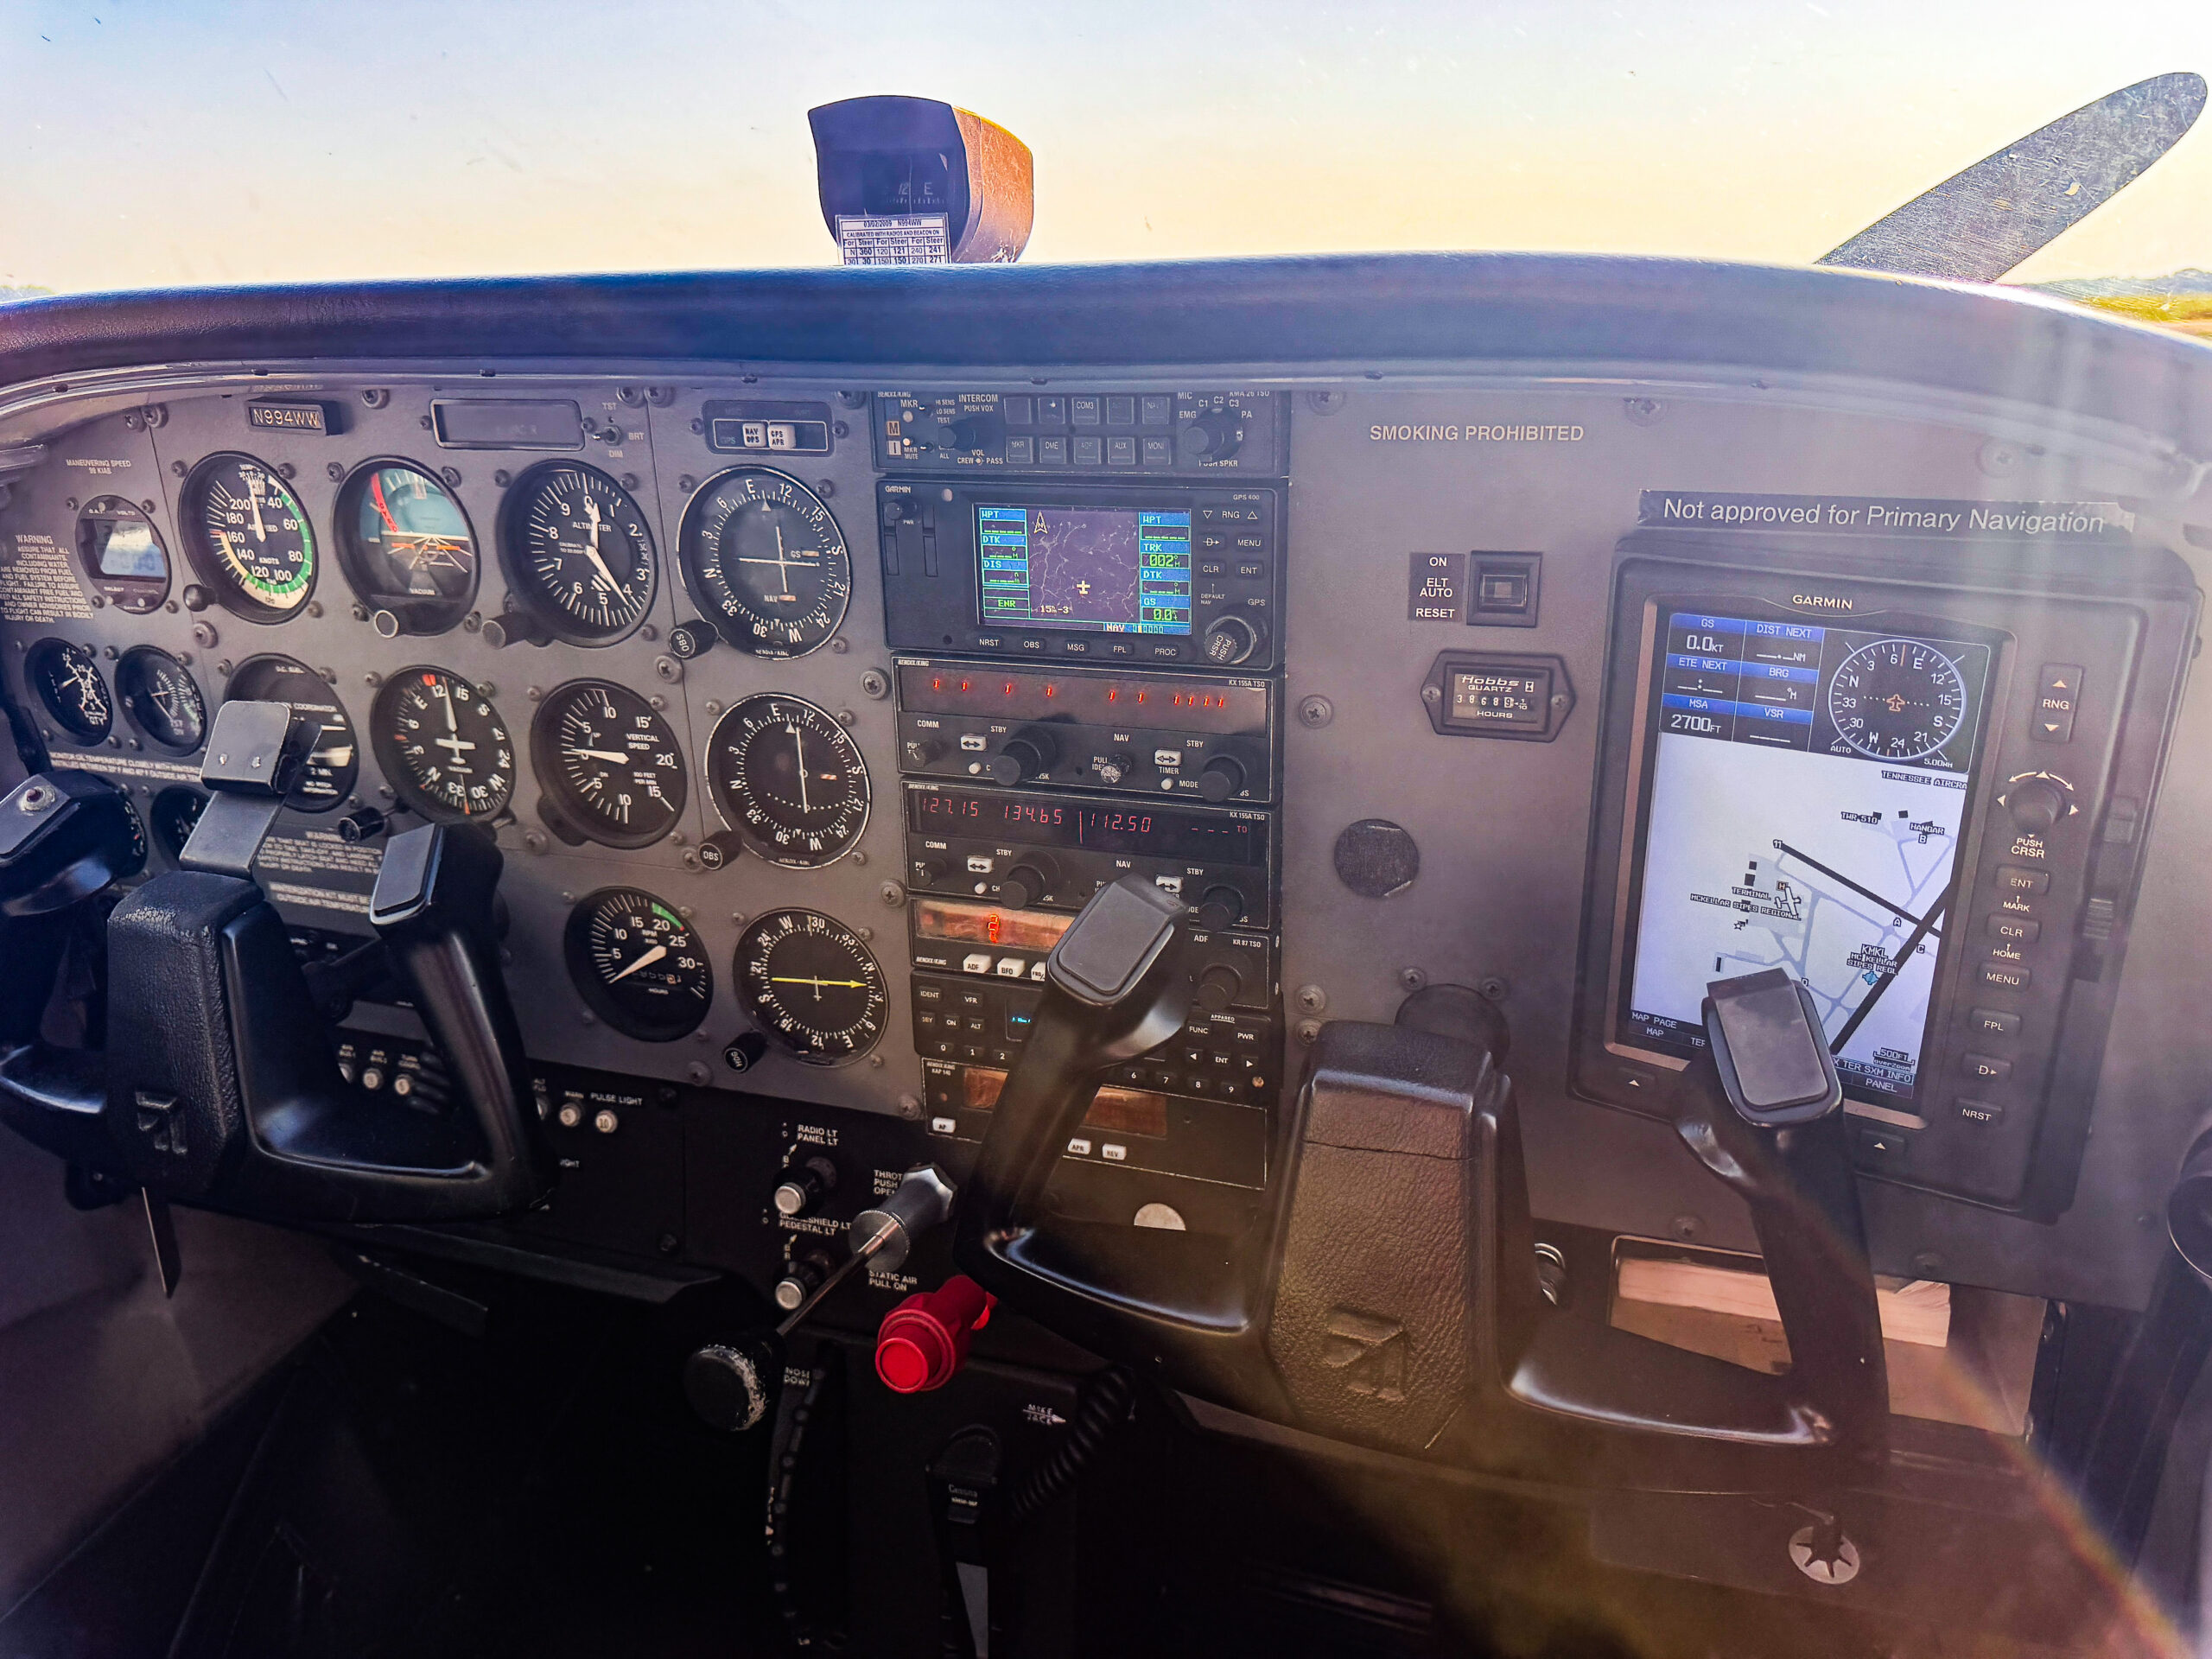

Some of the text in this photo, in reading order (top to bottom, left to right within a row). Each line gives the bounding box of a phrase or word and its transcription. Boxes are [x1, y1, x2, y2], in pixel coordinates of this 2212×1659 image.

[958, 394, 998, 403] INTERCOM
[1177, 391, 1192, 400] MIC
[1213, 396, 1224, 404] C2
[900, 399, 918, 408] MKR
[1077, 401, 1094, 410] COM3
[253, 409, 319, 428] N994WW
[1179, 410, 1197, 419] EMG
[628, 432, 645, 441] BRT
[1370, 425, 1585, 442] SMOKING PROHIBITED
[229, 498, 251, 511] 200
[267, 496, 283, 508] 40
[226, 512, 245, 524] 180
[1662, 499, 2104, 534] Not approved for Primary Navigation
[283, 518, 298, 531] 60
[227, 531, 245, 543] 160
[1237, 538, 1262, 547] MENU
[238, 548, 255, 561] 140
[288, 550, 303, 563] 80
[983, 560, 1001, 569] DIS
[1428, 556, 1448, 567] ON
[251, 565, 270, 578] 120
[275, 569, 293, 582] 100
[1143, 570, 1162, 579] DTK
[1426, 577, 1448, 588] ELT
[1419, 588, 1453, 598] AUTO
[1247, 598, 1266, 607] GPS
[1792, 594, 1853, 610] GARMIN
[1415, 607, 1456, 619] RESET
[1106, 624, 1125, 632] NAV
[1700, 618, 1812, 639] GS DIST NEXT
[1023, 640, 1039, 649] OBS
[1067, 643, 1084, 652] MSG
[1679, 658, 1727, 671] ETE NEXT
[1769, 667, 1789, 678] BRG
[1462, 675, 1520, 688] Hobbs
[1930, 673, 1945, 685] 12
[1468, 684, 1512, 693] QUARTZ
[1688, 698, 1708, 709] MSA
[1841, 696, 1857, 709] 33
[1937, 694, 1952, 706] 15
[2042, 698, 2070, 710] RNG
[1477, 710, 1513, 719] HOURS
[1764, 708, 1784, 719] VSR
[917, 720, 939, 728] COMM
[626, 733, 660, 743] VERTICAL
[1114, 733, 1129, 742] NAV
[1890, 738, 1905, 749] 24
[628, 742, 651, 751] SPEED
[1830, 745, 1852, 754] AUTO
[656, 753, 674, 766] 20
[1158, 766, 1179, 775] TIMER
[1881, 771, 1932, 785] TENNESSEE
[1910, 823, 1945, 835] HANGAR
[925, 841, 947, 849] COMM
[2016, 837, 2044, 849] PUSH
[2011, 845, 2045, 859] CRSR
[1116, 860, 1131, 868] NAV
[2010, 878, 2033, 888] ENT
[1732, 887, 1771, 901] TERMINAL
[2003, 901, 2031, 912] MARK
[630, 916, 645, 929] 15
[652, 918, 671, 931] 20
[614, 928, 628, 941] 10
[1999, 925, 2024, 938] CLR
[669, 934, 687, 948] 25
[1193, 934, 1209, 943] ADF
[1993, 948, 2022, 960] HOME
[678, 957, 696, 969] 30
[1001, 967, 1014, 976] BFO
[1986, 971, 2020, 986] MENU
[920, 990, 939, 999] IDENT
[1631, 1011, 1678, 1029] MAP PAGE
[1984, 1020, 2005, 1032] FPL
[1189, 1026, 1209, 1034] FUNC
[1237, 1032, 1255, 1040] PWR
[1646, 1027, 1664, 1037] MAP
[1864, 1065, 1912, 1083] SXM INFO
[1866, 1077, 1898, 1093] PANEL
[590, 1092, 643, 1106] PULSE LIGHT
[1961, 1109, 1993, 1122] NRST
[798, 1124, 838, 1138] RADIO LT
[797, 1133, 839, 1147] PANEL LT
[779, 1219, 836, 1236] PEDESTAL LT
[868, 1278, 907, 1292] PULL ON
[901, 1275, 918, 1285] AIR
